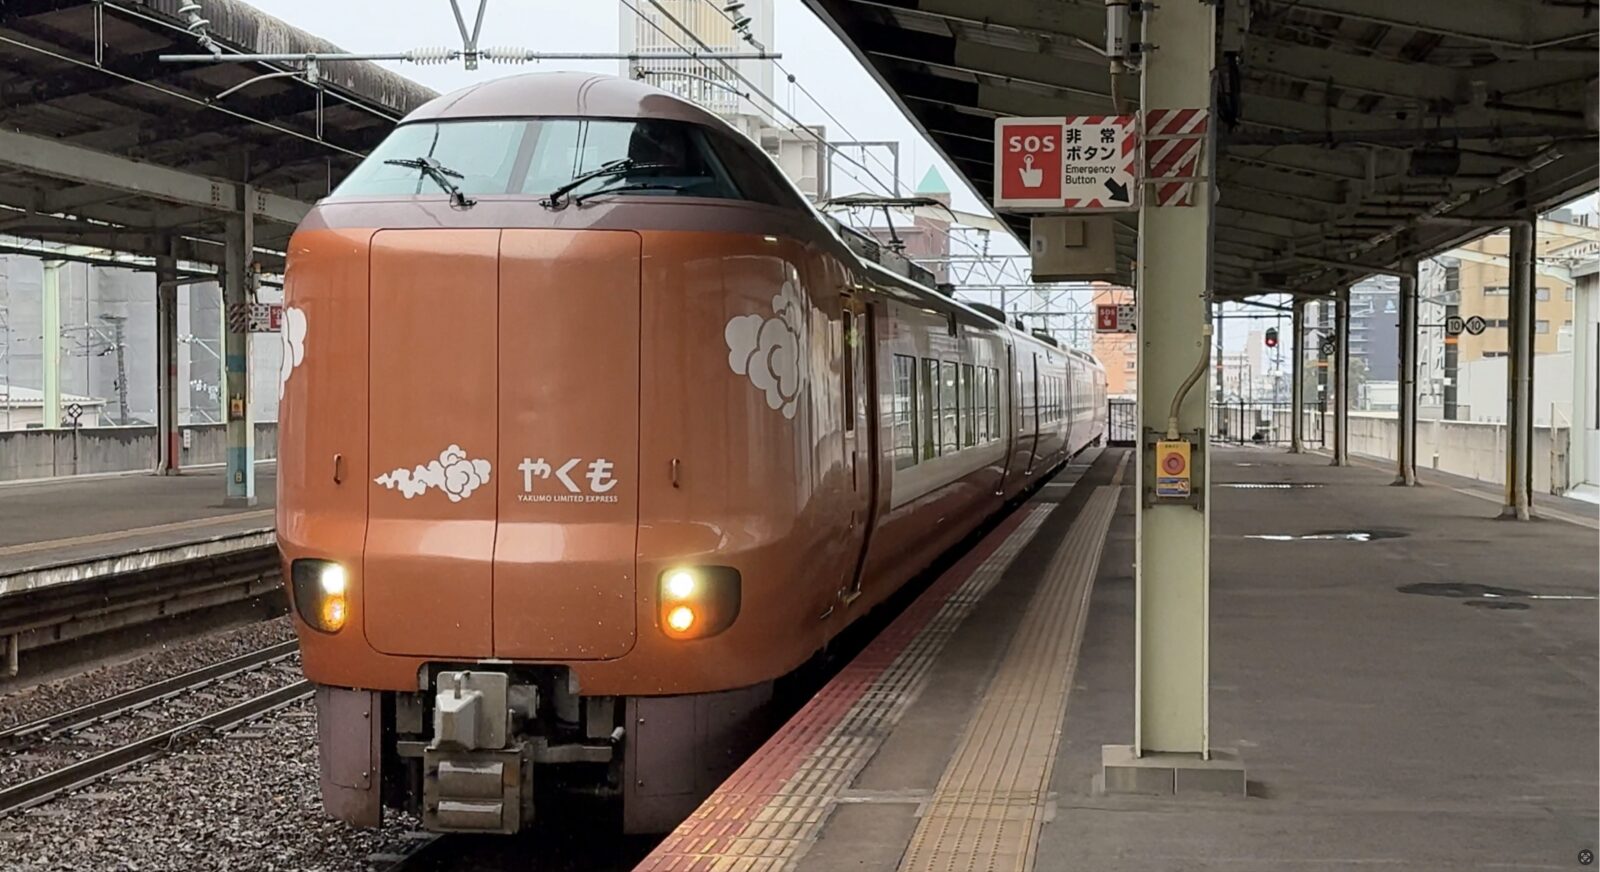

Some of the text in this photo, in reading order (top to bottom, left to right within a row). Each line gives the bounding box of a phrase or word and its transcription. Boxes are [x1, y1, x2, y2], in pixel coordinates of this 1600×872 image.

[1065, 128, 1116, 144] 非常
[1009, 135, 1056, 153] SOS
[1066, 145, 1116, 161] ボタン
[1065, 163, 1117, 175] Emergency
[1065, 174, 1097, 185] Button
[1100, 308, 1116, 316] SOS
[1450, 320, 1461, 331] 10
[1470, 320, 1481, 331] 10
[517, 457, 619, 493] やくも
[517, 494, 619, 503] YAKUMO LIMITED EXPRESS
